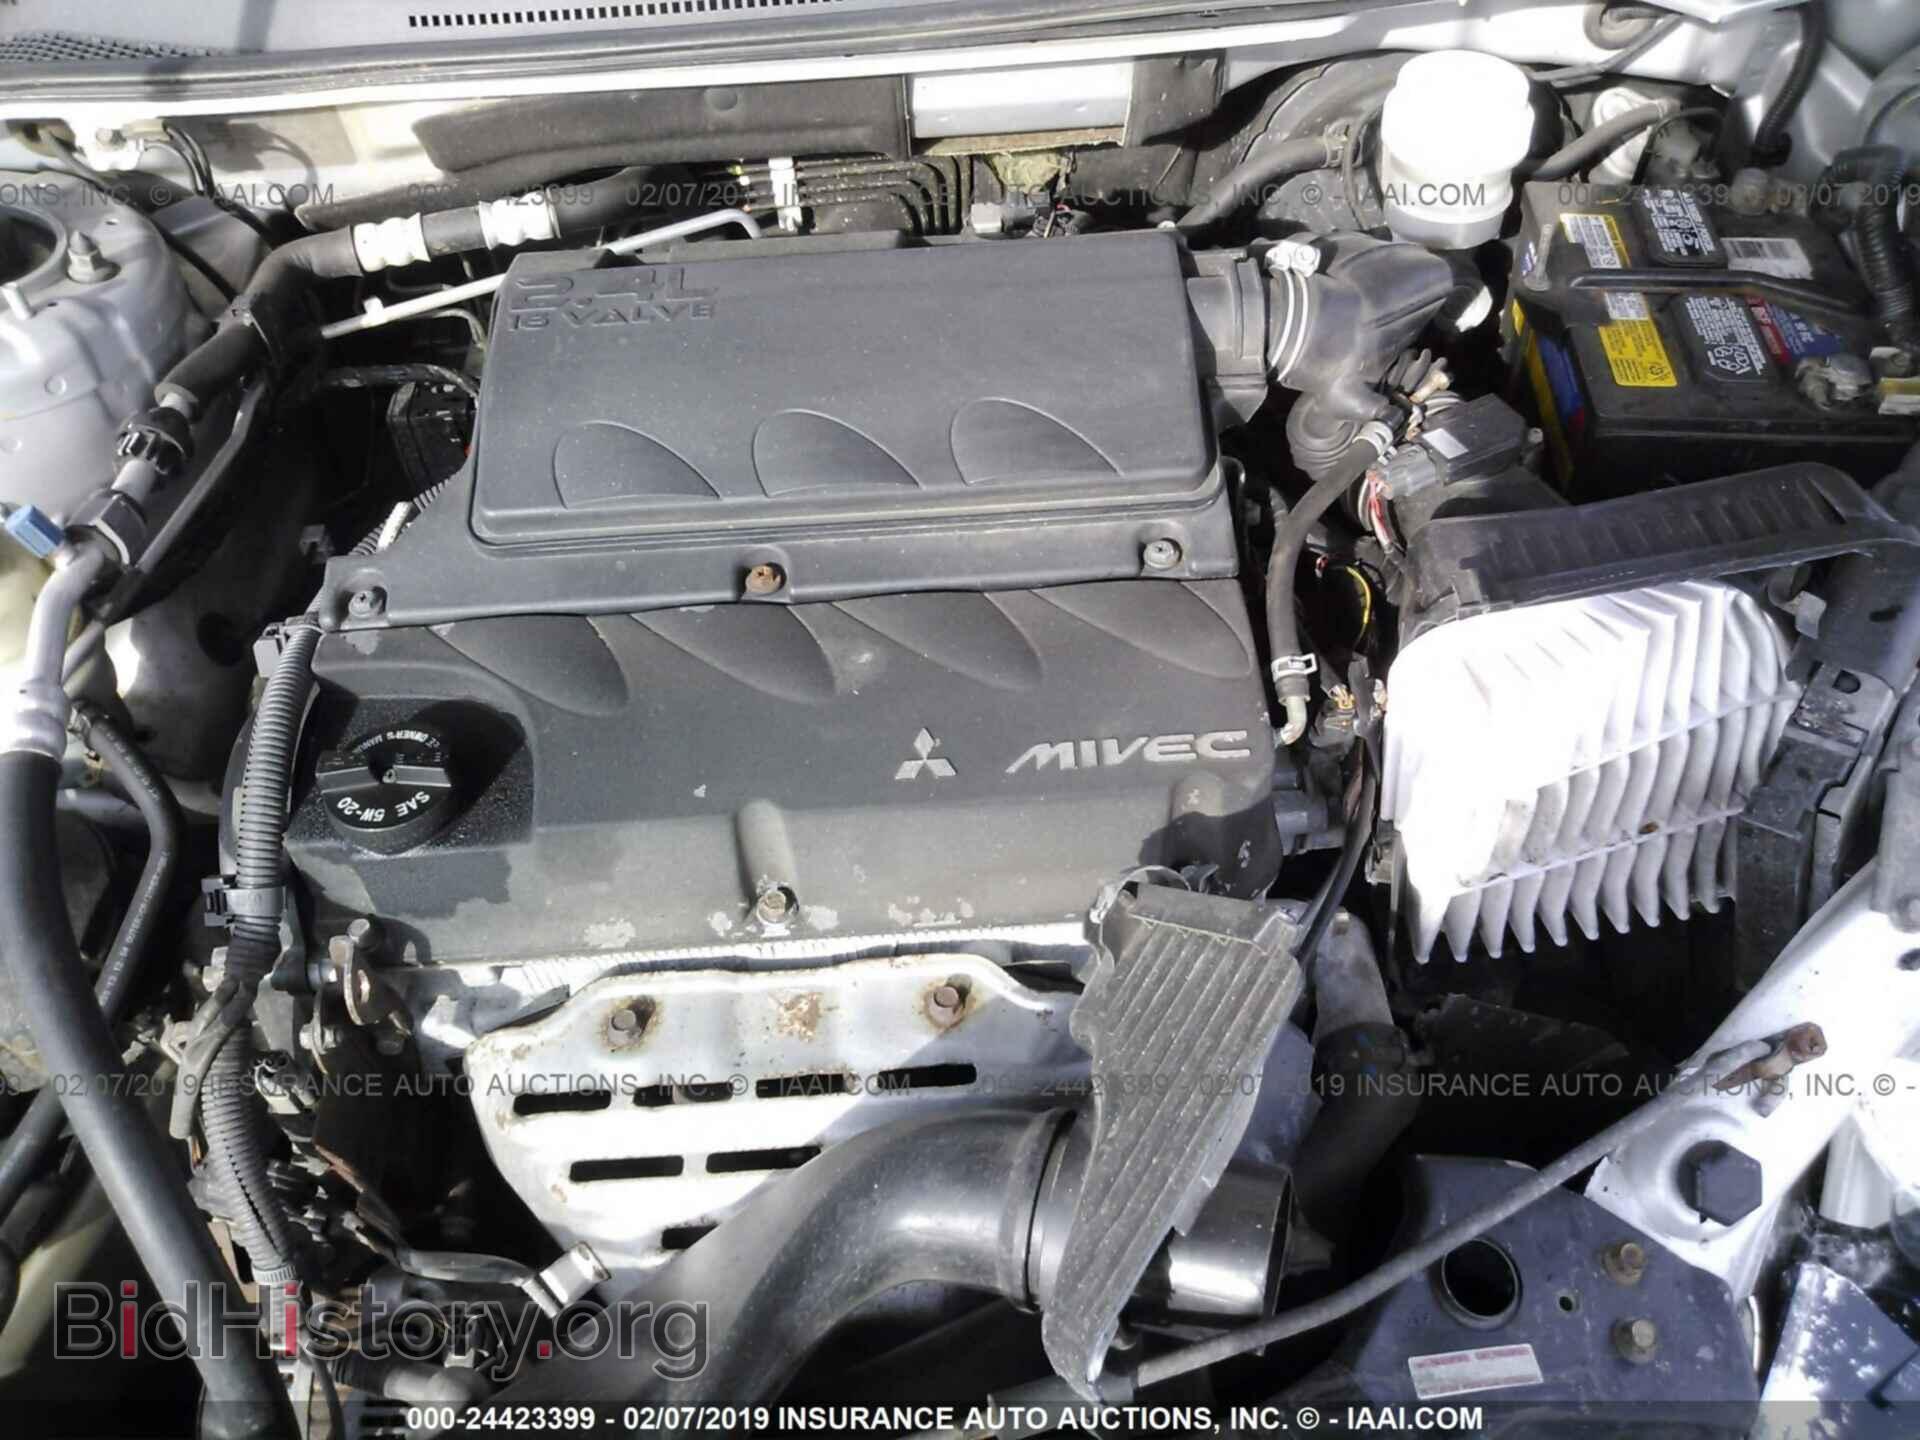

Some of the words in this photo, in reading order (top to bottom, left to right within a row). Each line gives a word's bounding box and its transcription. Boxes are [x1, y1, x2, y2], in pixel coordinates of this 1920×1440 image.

[562, 303, 714, 328] VALVE
[1005, 730, 1251, 774] MIVEC
[336, 796, 386, 822] 5W-20
[395, 791, 430, 817] SAE
